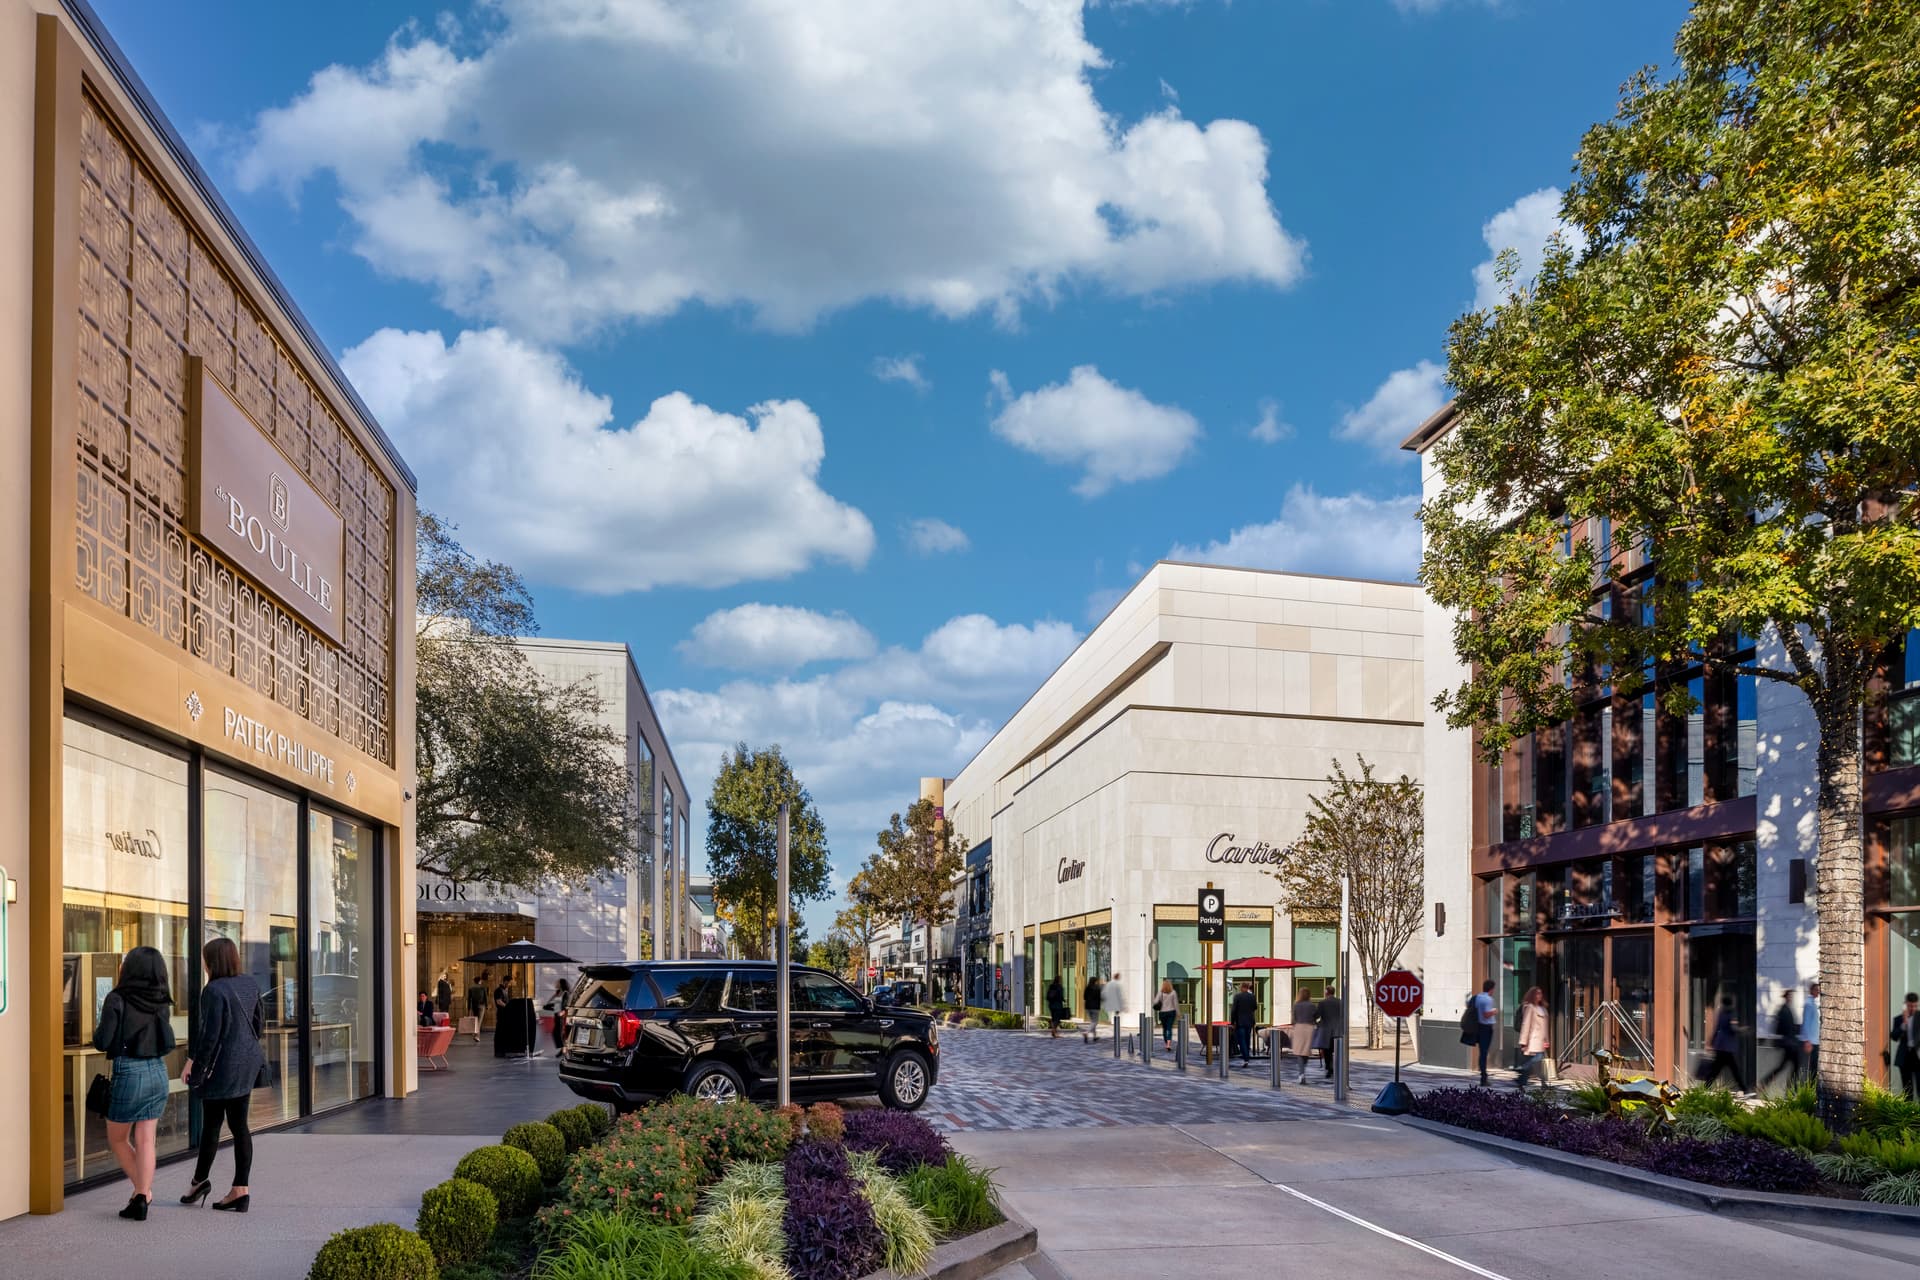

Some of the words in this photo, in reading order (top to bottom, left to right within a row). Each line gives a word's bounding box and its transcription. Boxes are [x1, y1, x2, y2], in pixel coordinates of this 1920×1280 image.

[273, 491, 286, 520] B
[215, 484, 227, 503] de
[226, 492, 332, 613] BOULLE
[224, 706, 274, 758] PATEK
[277, 732, 335, 785] PHILIPPE
[1206, 832, 1294, 865] Cartier
[1058, 856, 1085, 884] Cartier
[1208, 898, 1216, 910] P
[1200, 916, 1223, 926] Parking
[1378, 985, 1421, 1003] STOP
